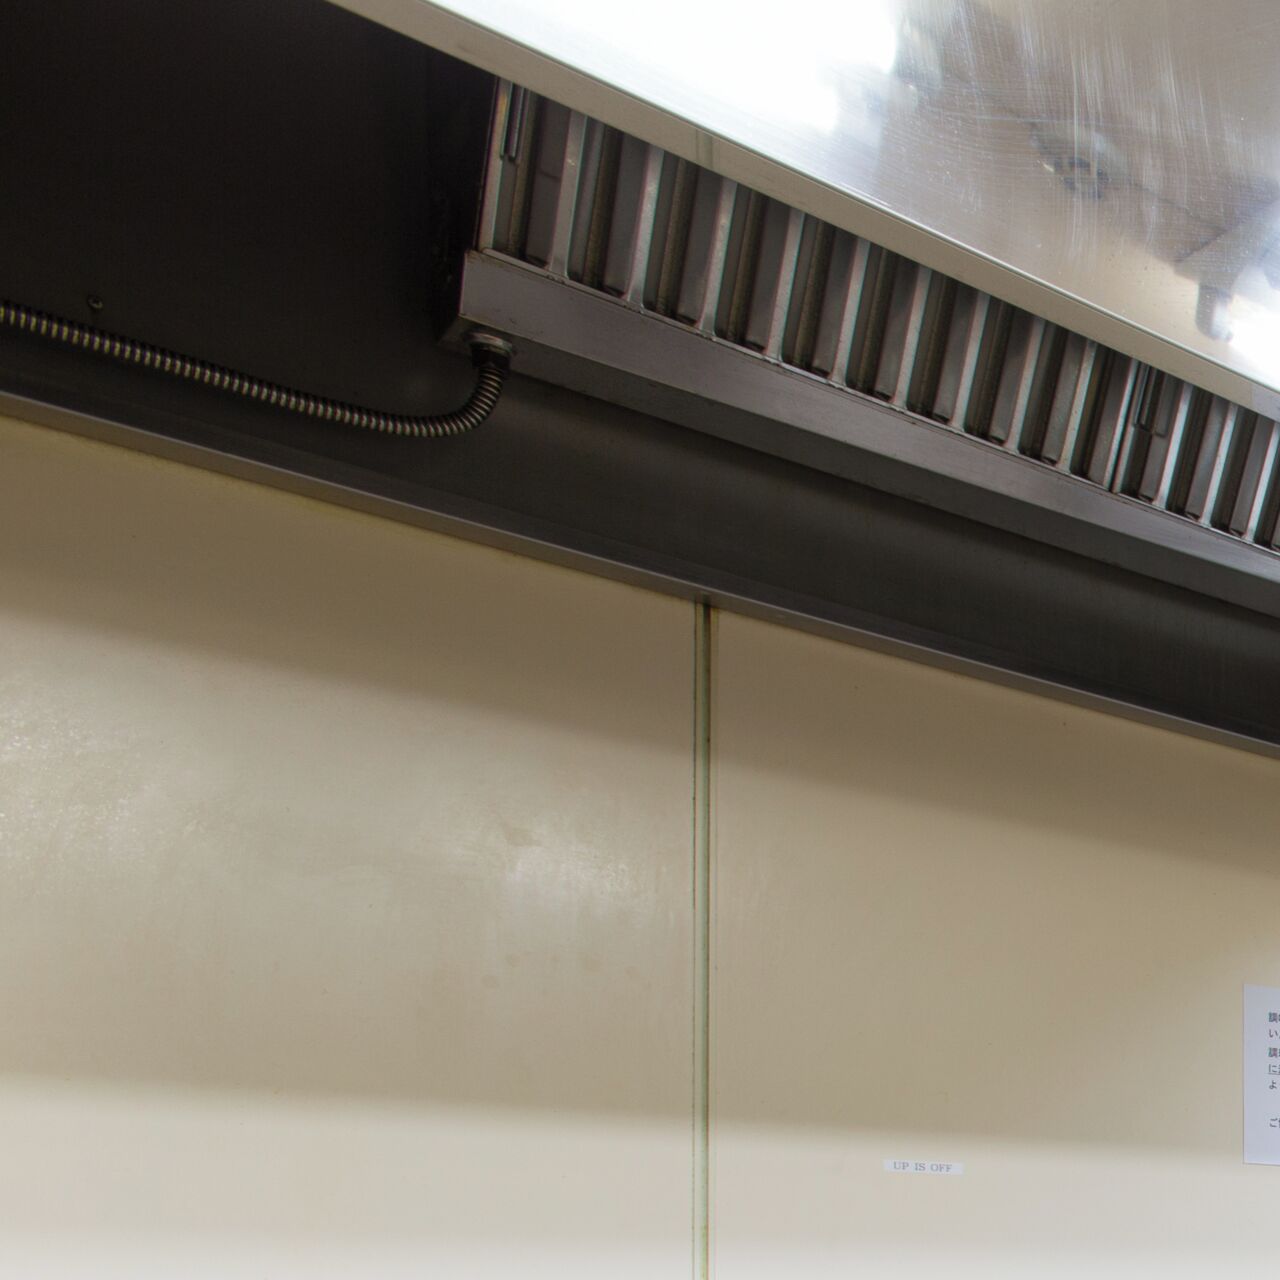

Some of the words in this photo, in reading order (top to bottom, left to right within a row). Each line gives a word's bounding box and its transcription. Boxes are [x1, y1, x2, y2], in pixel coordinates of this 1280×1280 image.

[893, 1161, 910, 1170] UP
[915, 1162, 926, 1171] IS
[930, 1163, 953, 1172] OFF
